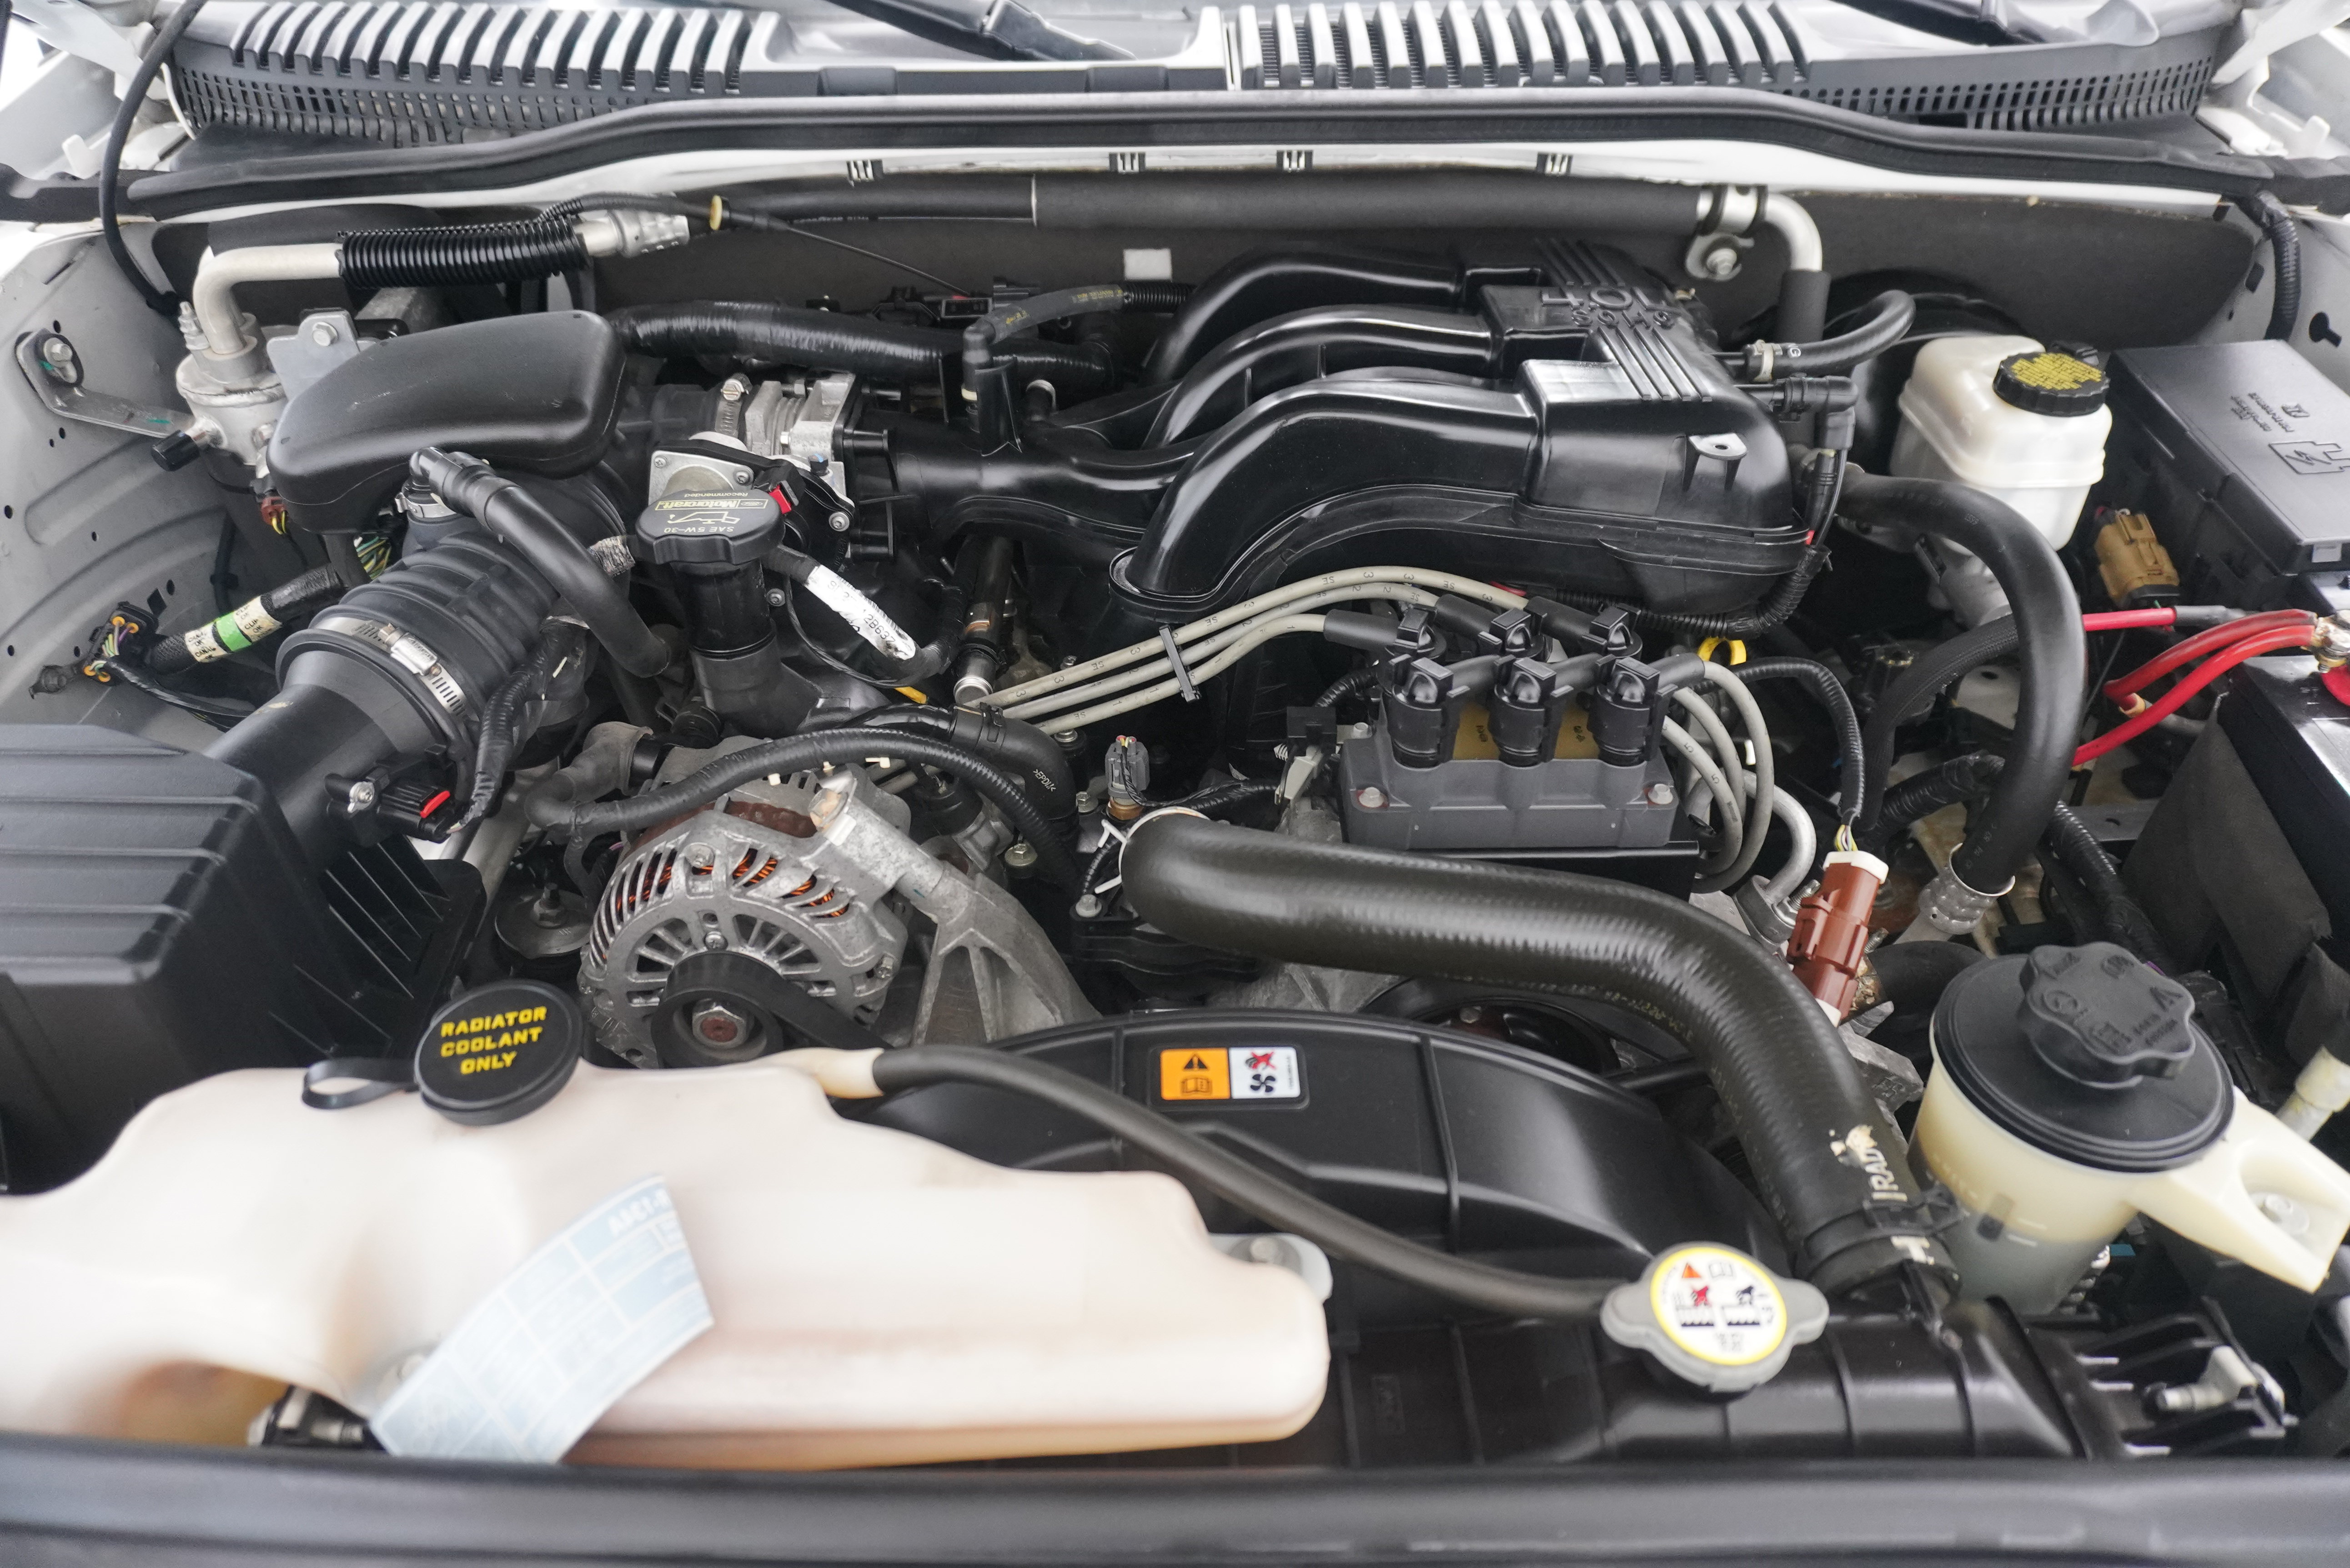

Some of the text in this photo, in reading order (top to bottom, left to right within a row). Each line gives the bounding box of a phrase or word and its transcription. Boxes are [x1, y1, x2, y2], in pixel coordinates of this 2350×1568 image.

[663, 500, 738, 509] Motorcraft
[253, 625, 264, 633] OK
[440, 1005, 547, 1038] RADIATOR
[440, 1026, 543, 1058] COOLANT
[460, 1050, 518, 1075] ONLY
